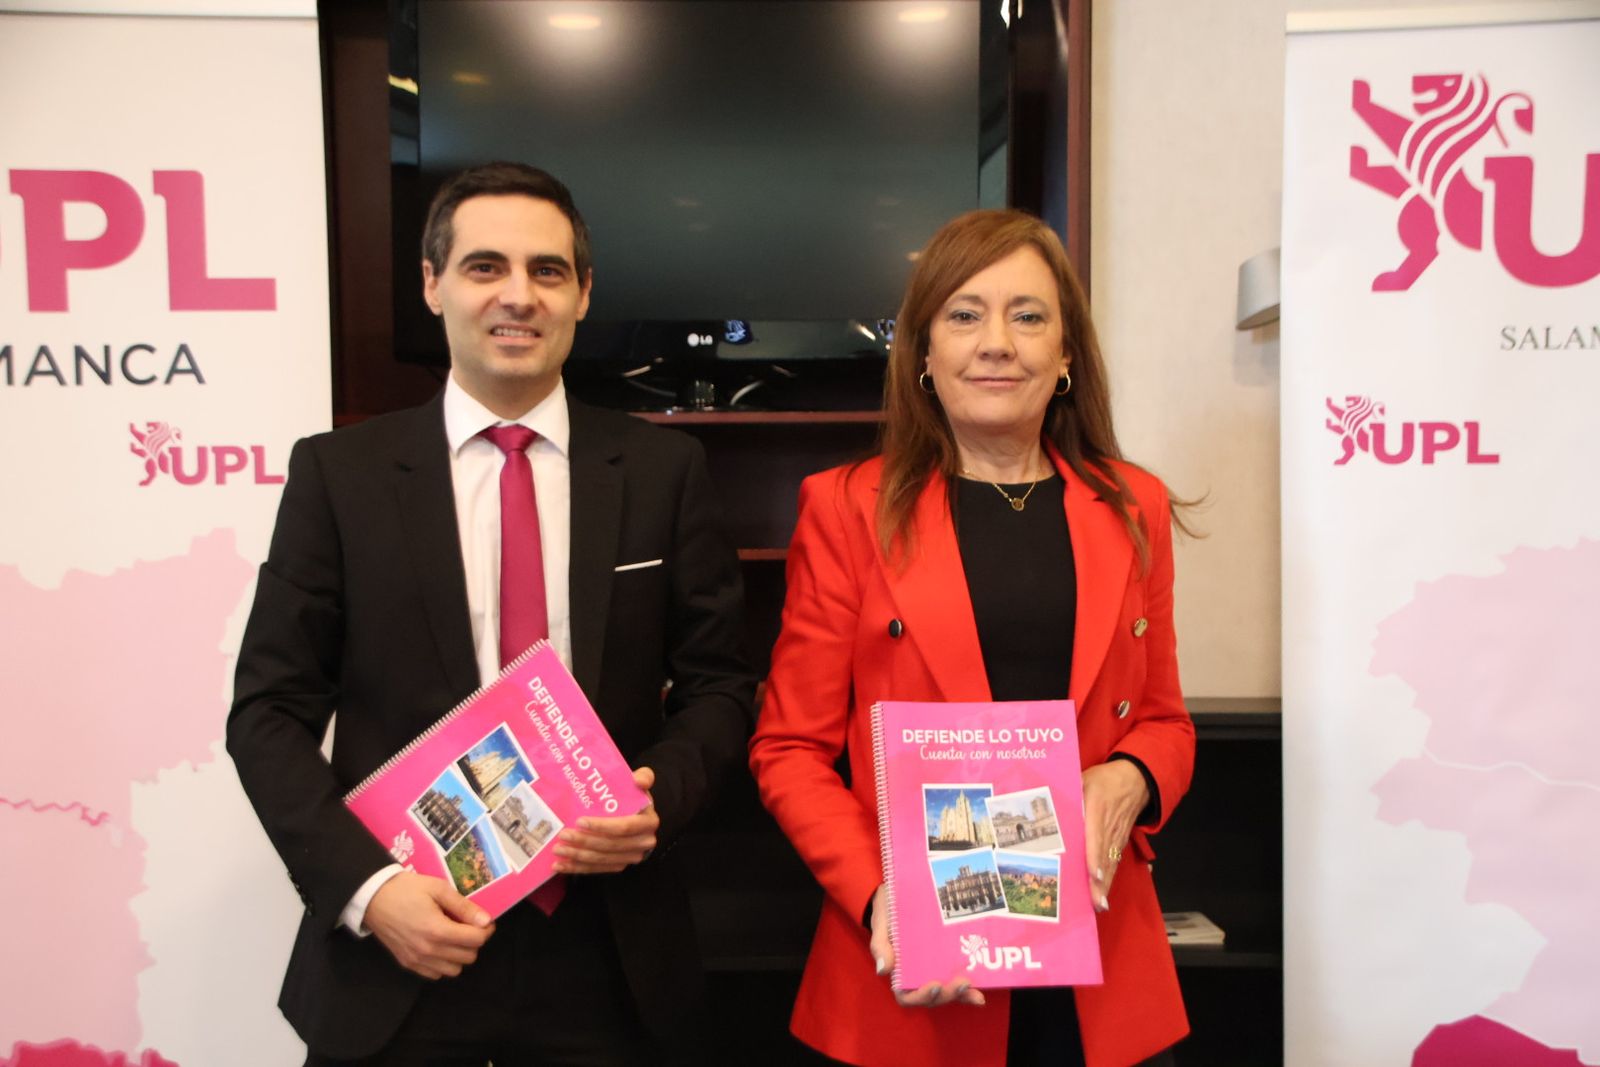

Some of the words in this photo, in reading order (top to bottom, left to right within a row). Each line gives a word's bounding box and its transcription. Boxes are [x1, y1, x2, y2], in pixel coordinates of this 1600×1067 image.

[0, 169, 277, 313] PL
[1369, 421, 1500, 465] UPL
[168, 445, 285, 486] UPL
[524, 700, 552, 743] Cuenta
[549, 743, 565, 764] con
[562, 763, 594, 809] nosotros
[528, 676, 579, 750] DEFIENDE
[572, 746, 592, 770] LO
[586, 768, 618, 813] TUYO
[902, 729, 985, 744] DEFIENDE
[988, 729, 1012, 743] LO
[1015, 728, 1064, 743] TUYO
[919, 744, 967, 761] Cuenta
[969, 749, 993, 760] con
[996, 746, 1048, 760] nosotros
[981, 946, 1042, 970] UPL
